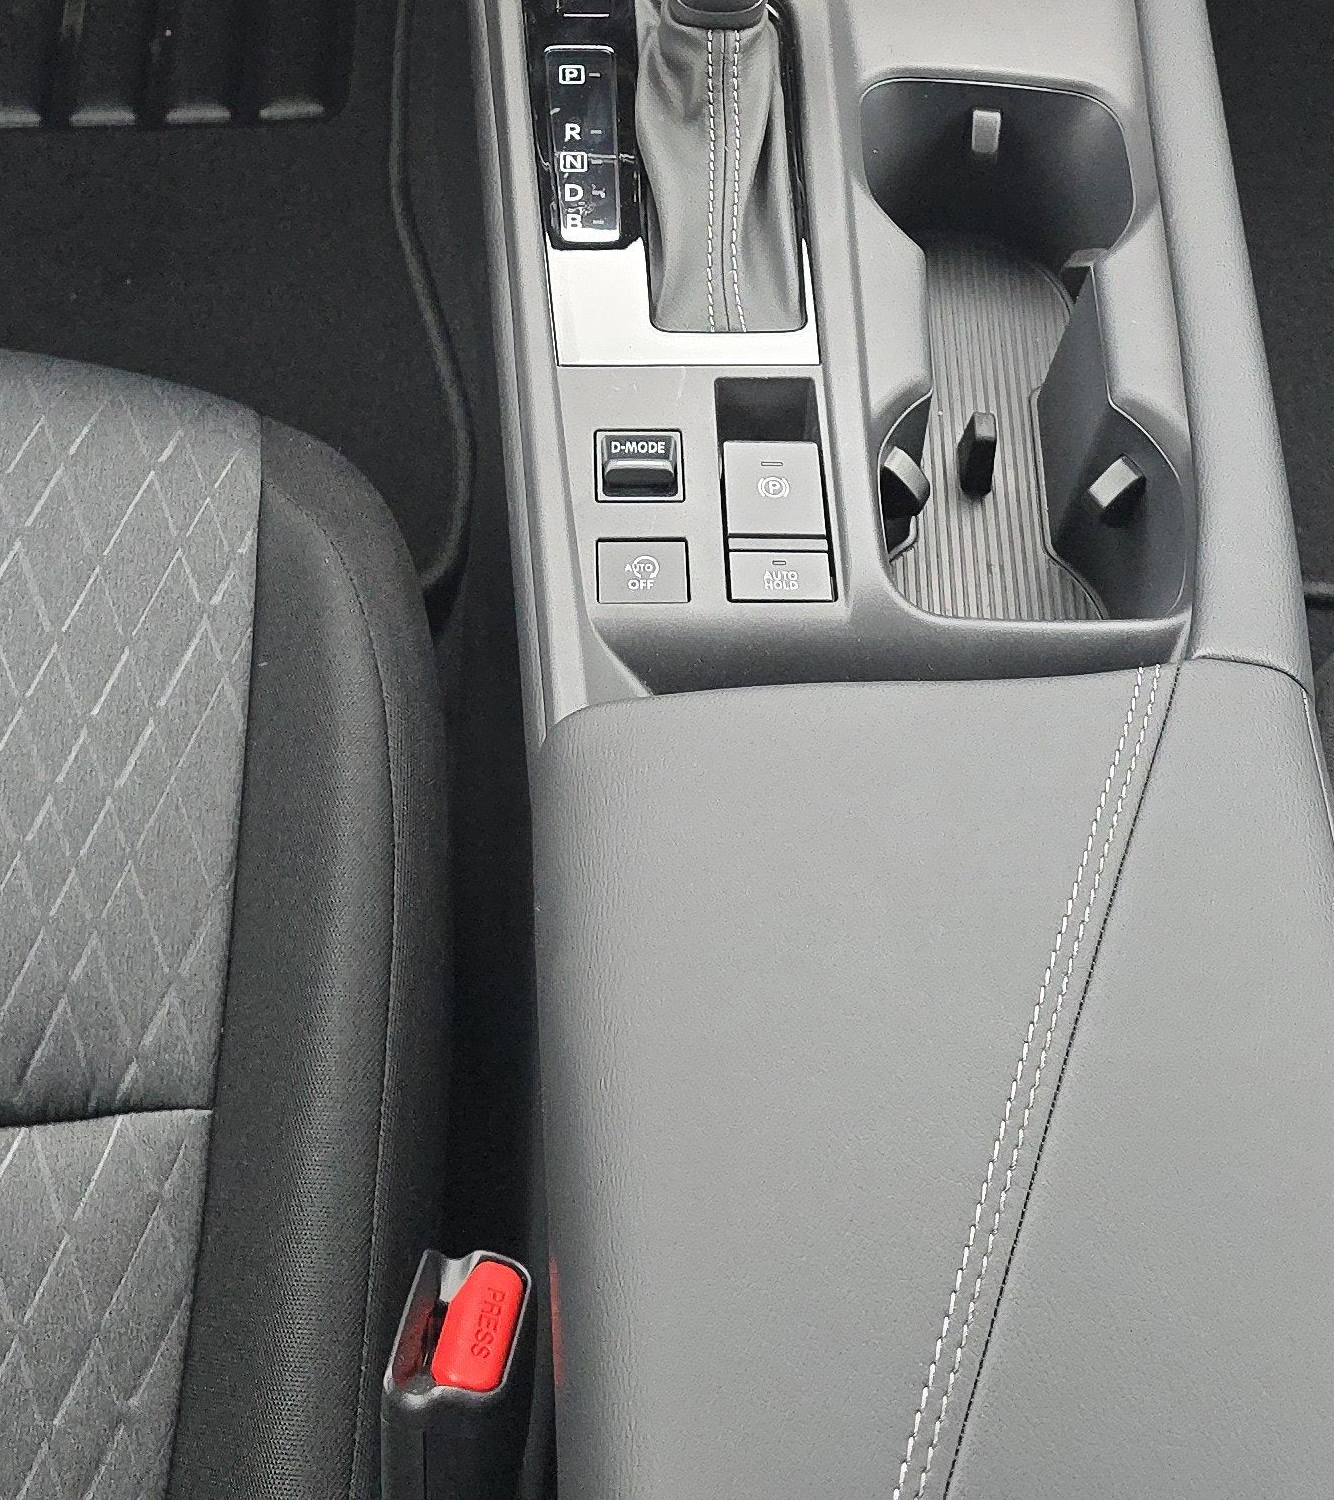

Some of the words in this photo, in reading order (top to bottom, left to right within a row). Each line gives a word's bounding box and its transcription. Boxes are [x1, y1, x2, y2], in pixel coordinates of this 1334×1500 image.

[564, 122, 582, 142] R
[565, 154, 583, 170] N
[564, 183, 584, 202] D
[610, 441, 666, 455] D-MODE
[624, 563, 654, 573] AUTO
[763, 570, 799, 581] AUTO
[628, 579, 655, 591] OFF
[764, 580, 799, 591] HOLD
[470, 1286, 507, 1360] PRESS
